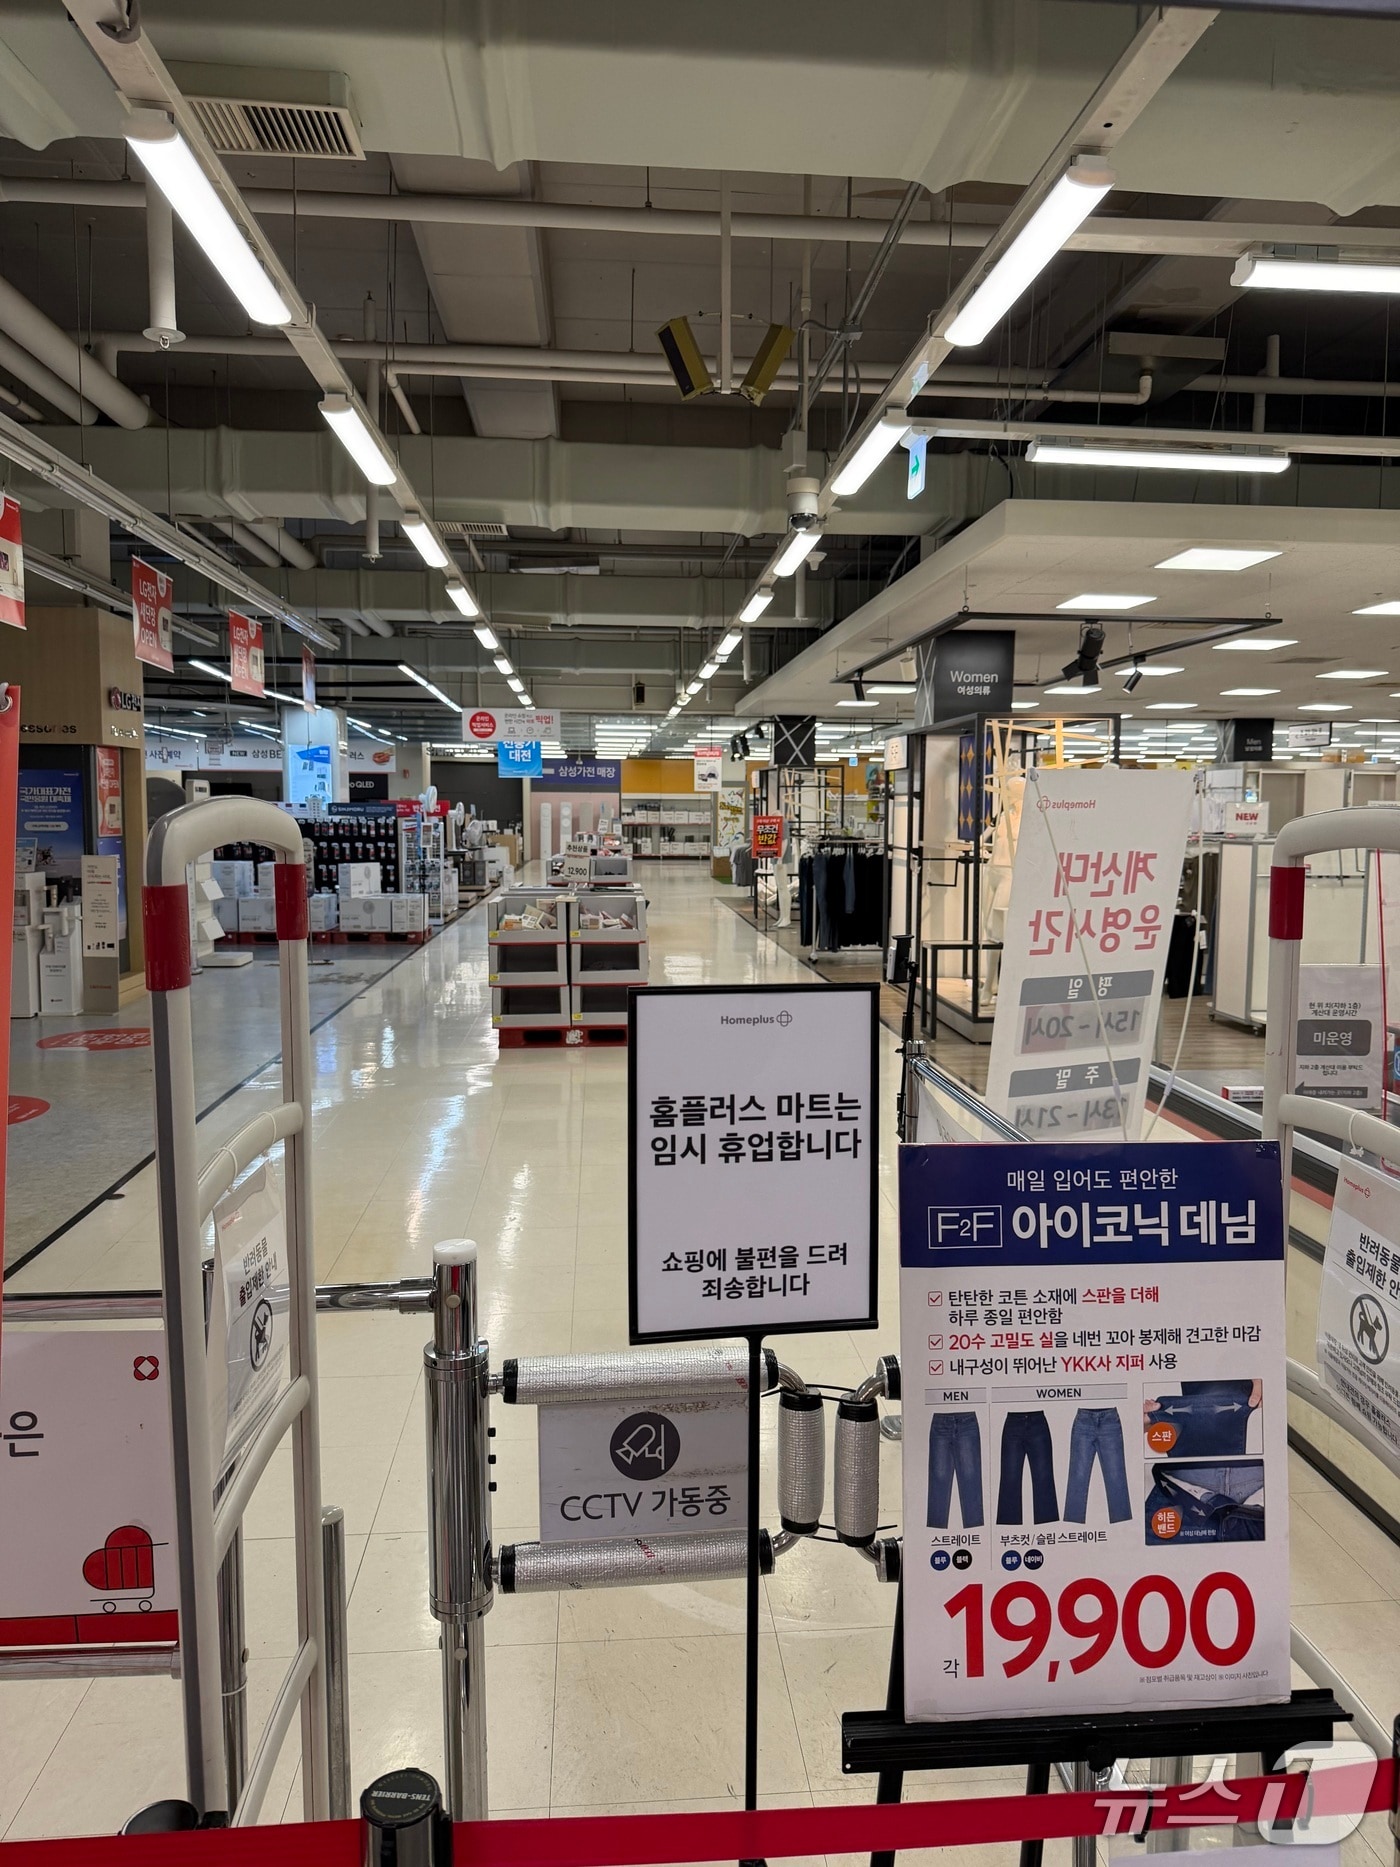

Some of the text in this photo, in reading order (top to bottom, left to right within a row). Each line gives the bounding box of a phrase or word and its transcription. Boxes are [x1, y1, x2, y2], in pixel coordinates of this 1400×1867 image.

[950, 671, 999, 683] Women
[957, 686, 991, 695] 여성의류
[509, 749, 532, 762] 대전
[558, 766, 616, 778] 삼성가전 매장
[1235, 812, 1259, 821] NEW
[758, 833, 777, 844] 반값
[1311, 1009, 1358, 1017] 계산대 운영시간
[720, 1014, 775, 1027] Homeplus
[1313, 1031, 1353, 1046] 미운영
[649, 1091, 862, 1128] 홈플러스 마트는
[650, 1128, 862, 1166] 임시 휴업합니다
[1006, 1167, 1179, 1193] 매일 입어도 편안한
[937, 1211, 994, 1243] F2F
[1011, 1199, 1256, 1249] 아이코닉 데님
[242, 1236, 269, 1276] 반려동물
[662, 1242, 848, 1273] 쇼핑에 불편을 드려
[1345, 1248, 1387, 1292] 출입제한
[239, 1251, 278, 1308] 출입제한 안내
[701, 1272, 810, 1301] 죄송합니다
[949, 1285, 1160, 1307] 탄탄한 코튼 소재에 스판을 더해
[949, 1307, 1063, 1327] 하루 종일 편안함
[949, 1324, 1261, 1351] 20수 고밀도 실을 네번 꼬아 봉제해 견고한 마감
[950, 1352, 1178, 1376] 내구성이 뛰어난 YKK사 지퍼 사용
[943, 1390, 969, 1401] MEN
[1036, 1388, 1082, 1399] WOMEN
[1152, 1430, 1172, 1443] 스판
[560, 1485, 731, 1521] CCTV 가동중
[1157, 1511, 1175, 1522] 히든
[1157, 1523, 1175, 1534] 밴드
[930, 1534, 981, 1547] 스트레이트
[1057, 1531, 1108, 1544] 스트레이트
[934, 1556, 969, 1565] 블루 블랙
[1025, 1555, 1043, 1564] 네이비
[943, 1571, 1256, 1683] 각 19,900
[371, 1790, 431, 1802] TENS-BARRIER
